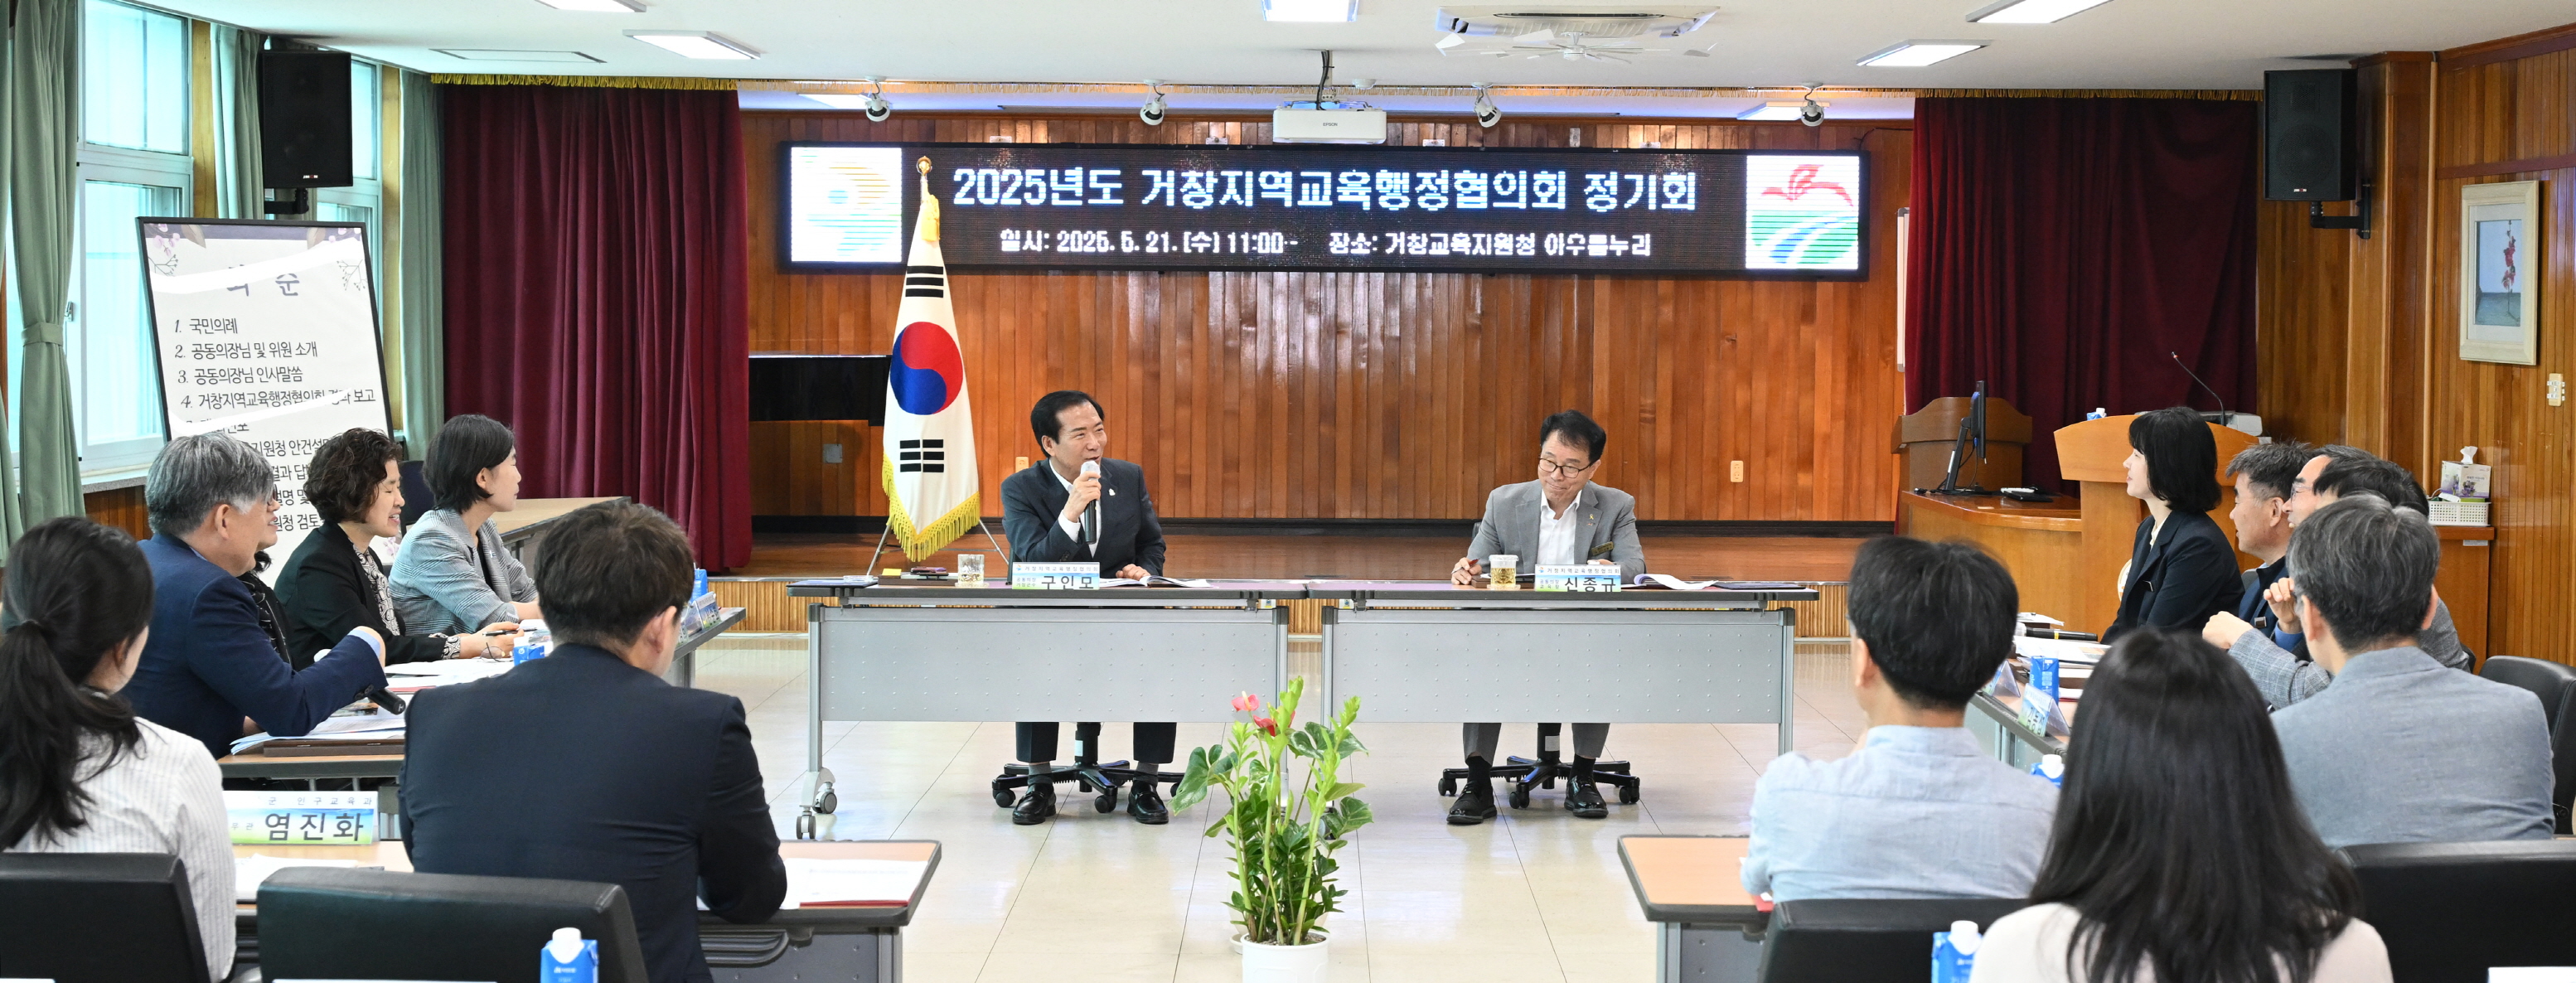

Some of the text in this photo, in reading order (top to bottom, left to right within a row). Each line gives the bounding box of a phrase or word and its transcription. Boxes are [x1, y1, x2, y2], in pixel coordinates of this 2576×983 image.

[953, 167, 1696, 212] 2025년도 거창지역교육행정협의회 정기회
[1000, 228, 1050, 252] 일시:
[1329, 232, 1378, 254] 장소:
[1385, 231, 1535, 256] 거창교육지원청
[175, 317, 239, 335] 1. 국민의례
[175, 341, 318, 360] 2. 공동의장님 및 위원 소개
[177, 366, 303, 385] 3. 공동의장님 인사말씀
[181, 398, 193, 409] 4.
[353, 389, 376, 403] 보고
[1041, 575, 1094, 589] 구인모
[1565, 577, 1616, 592] 신종규
[264, 812, 364, 842] 염진화
